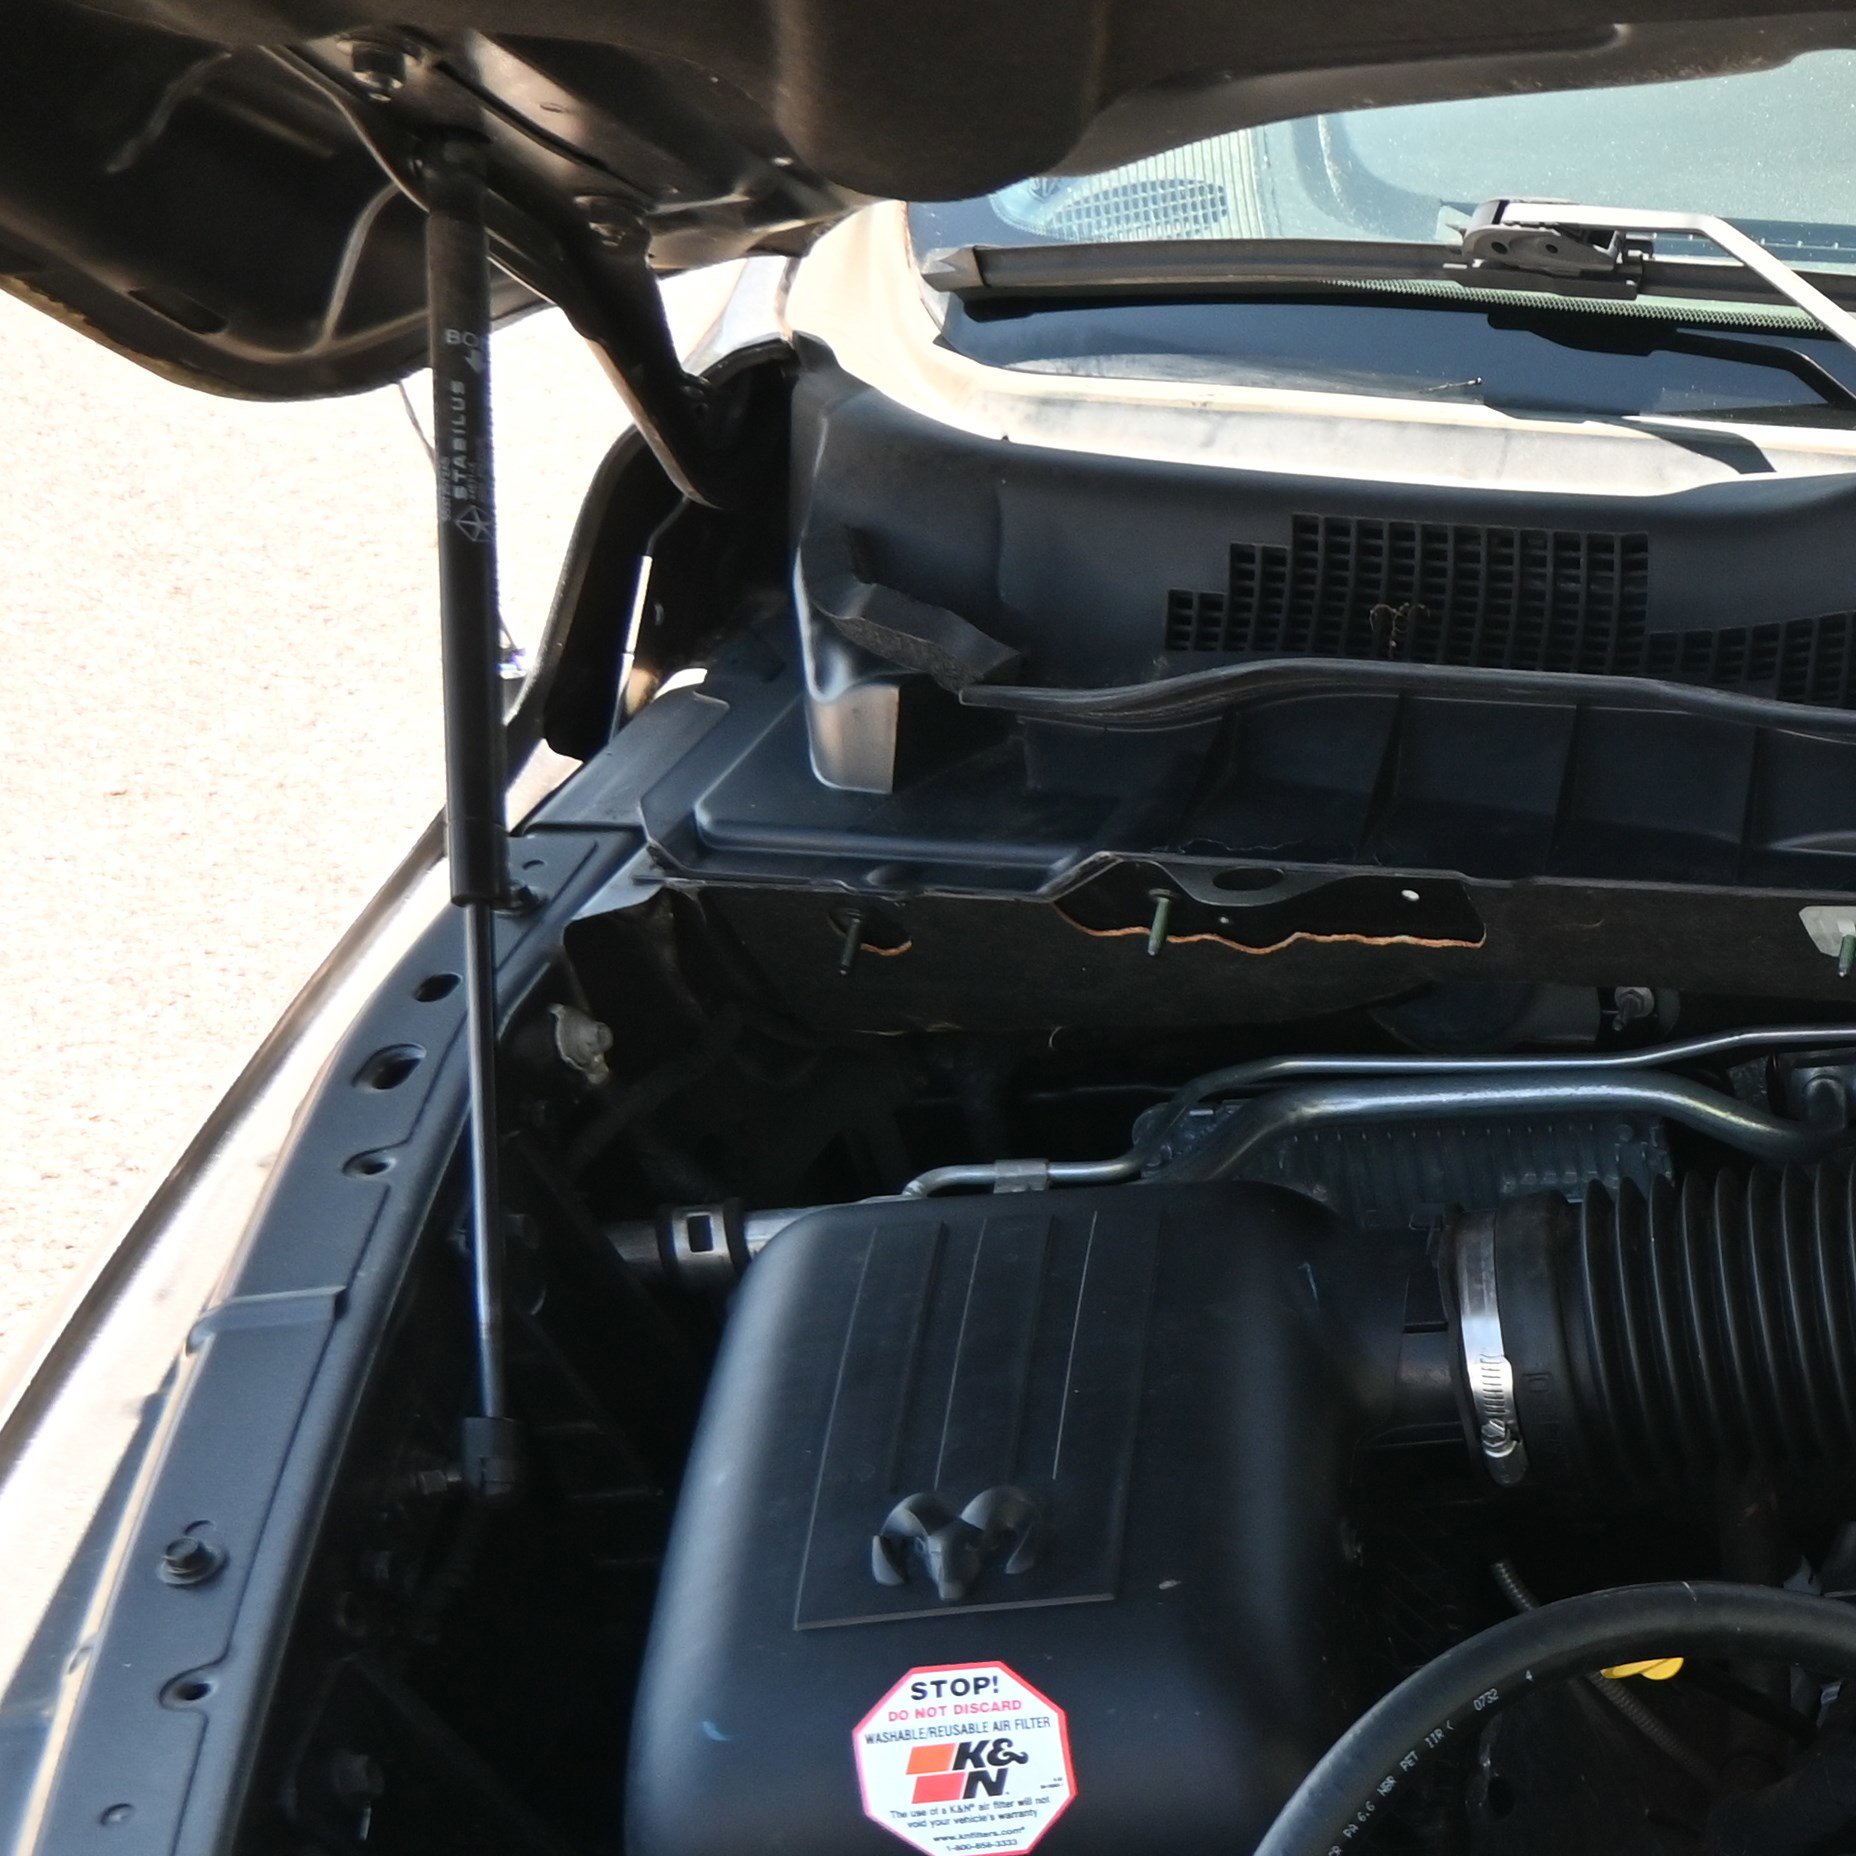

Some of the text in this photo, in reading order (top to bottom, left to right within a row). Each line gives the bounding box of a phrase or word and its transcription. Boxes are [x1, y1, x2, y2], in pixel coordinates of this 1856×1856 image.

[445, 328, 480, 347] BO
[450, 379, 468, 500] STABILUS
[911, 1676, 999, 1700] STOP!
[888, 1700, 1022, 1722] DO NOT DISCARD
[865, 1717, 1051, 1745] WASHABLE/REUSABLE AIR FILTER
[1342, 1823, 1359, 1838] PA
[1356, 1800, 1376, 1823] 6.6
[1376, 1775, 1397, 1797] NBR
[1399, 1751, 1419, 1772] PET
[890, 1810, 907, 1820] The
[911, 1809, 926, 1818] use
[930, 1807, 939, 1817] of
[978, 1802, 990, 1812] air
[993, 1799, 1014, 1811] filter
[1017, 1797, 1033, 1808] will
[1035, 1796, 1050, 1806] not
[907, 1809, 1038, 1829] void your vehicle's warranty
